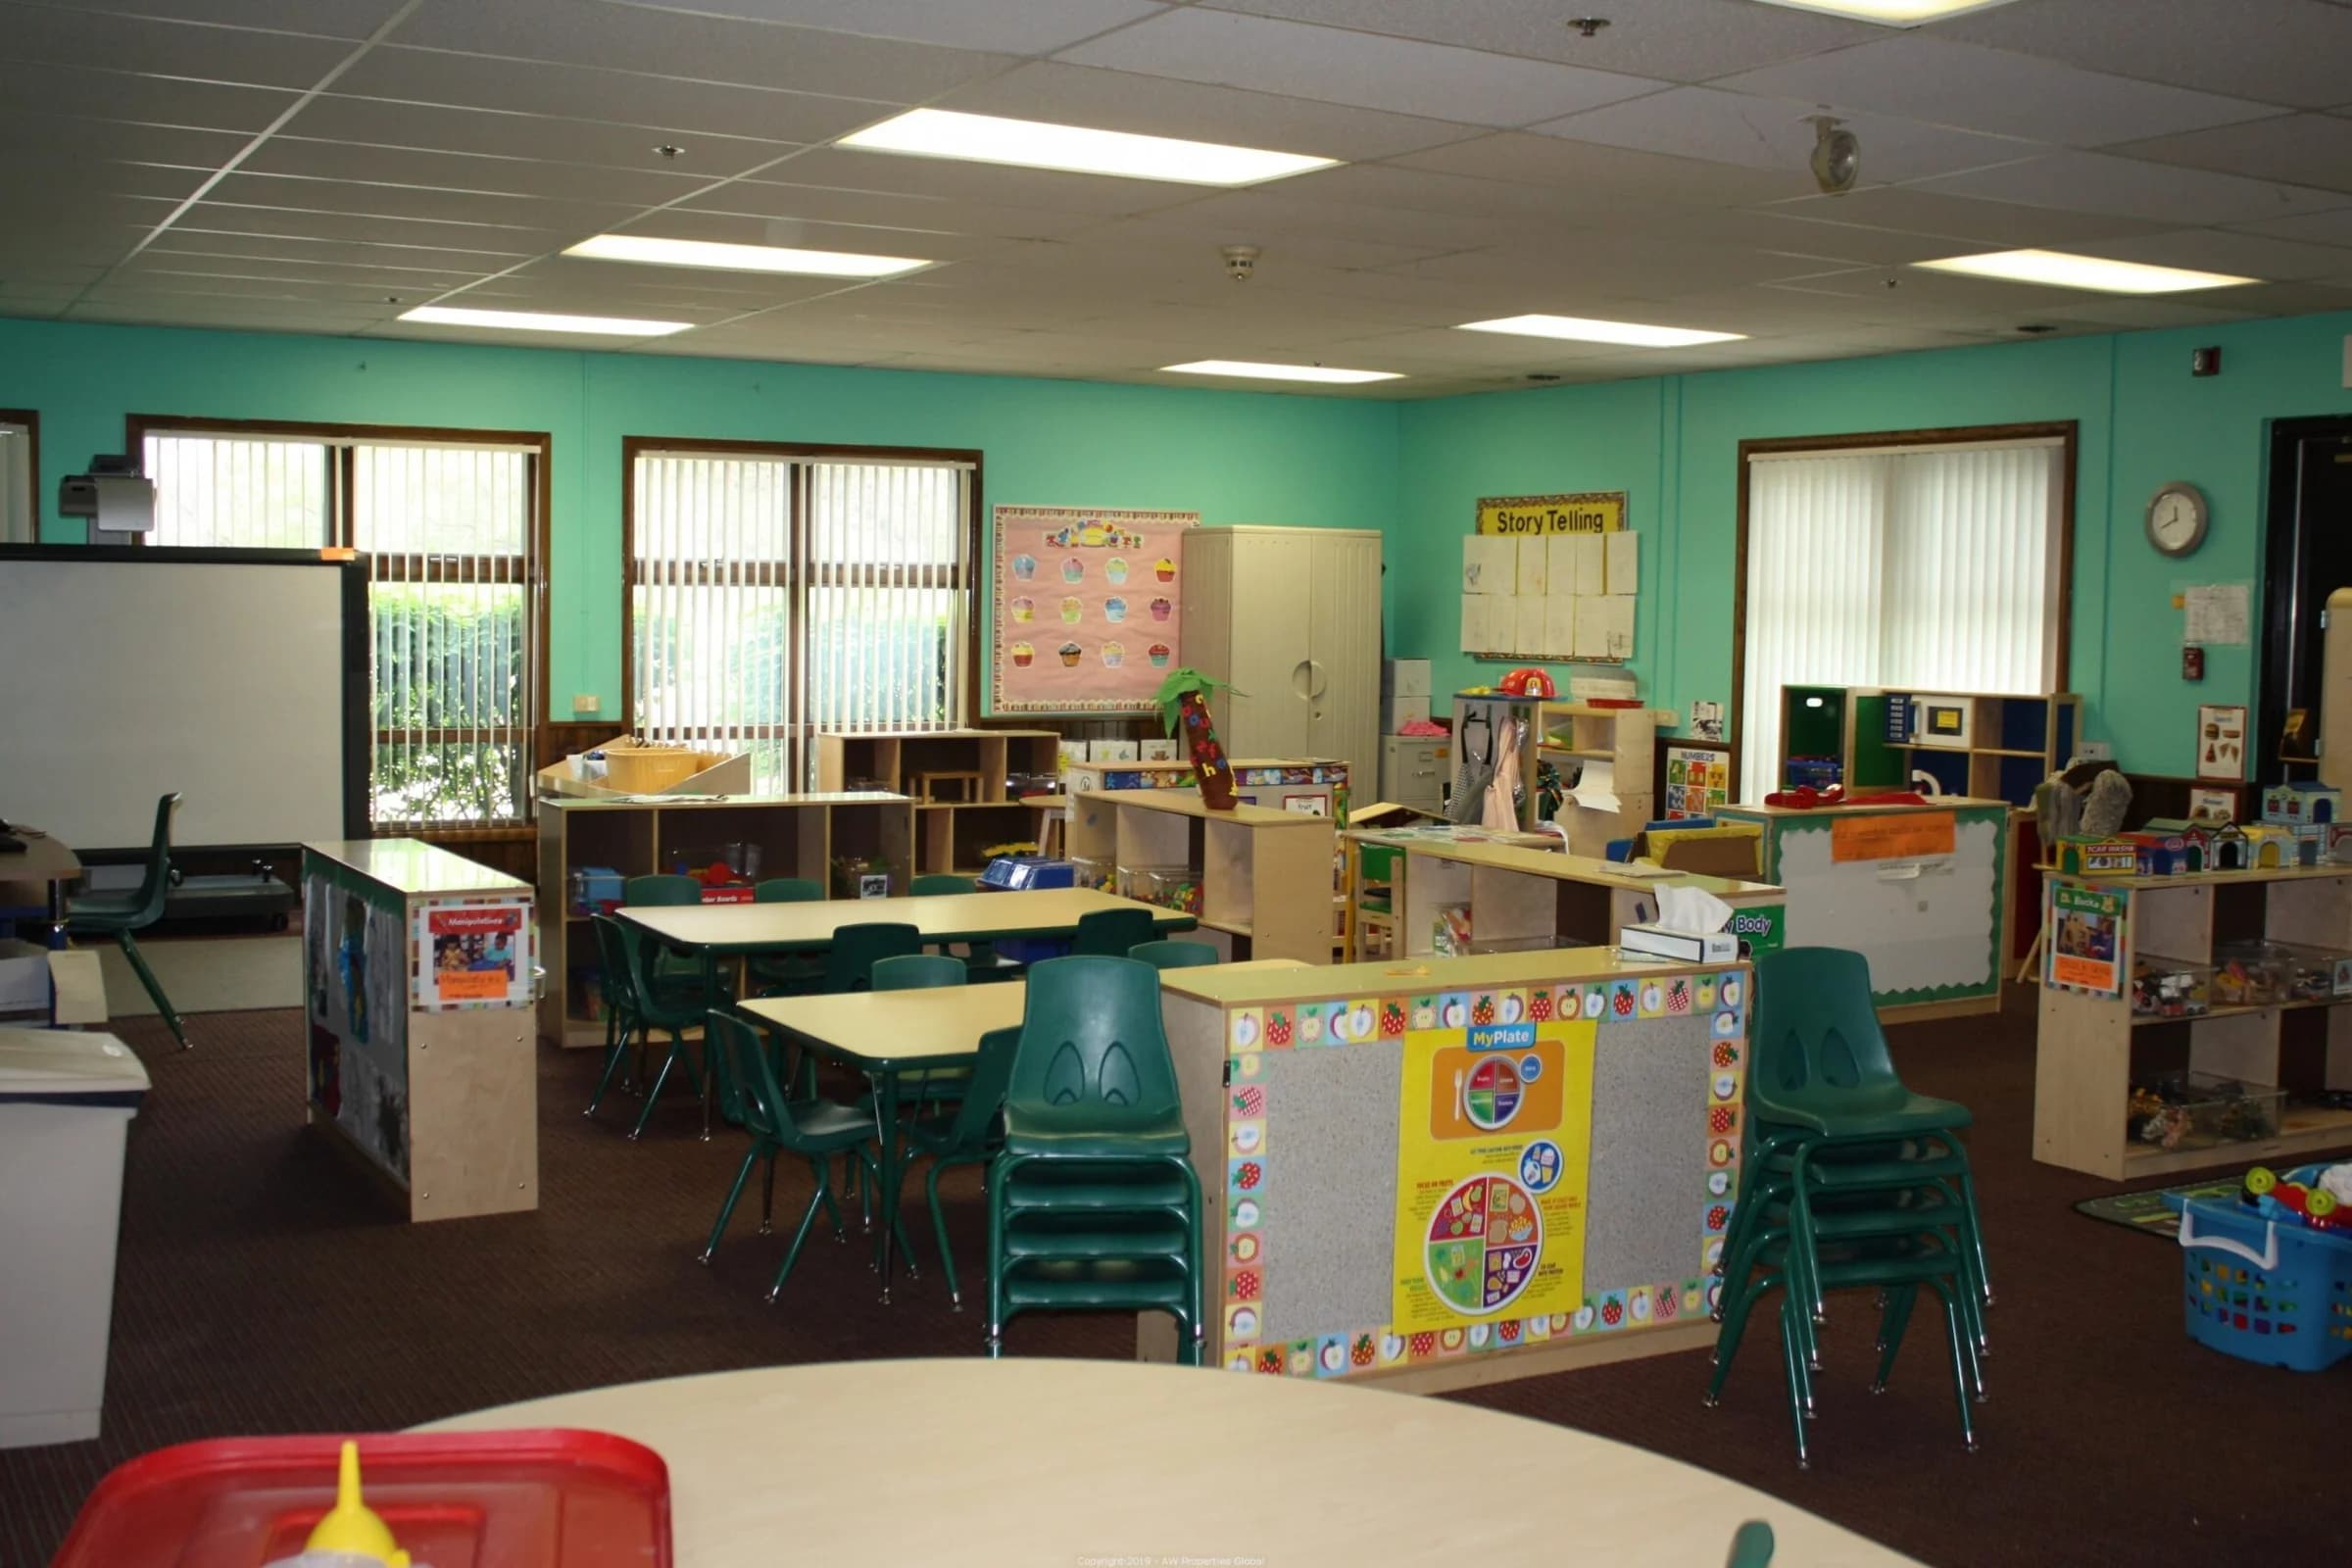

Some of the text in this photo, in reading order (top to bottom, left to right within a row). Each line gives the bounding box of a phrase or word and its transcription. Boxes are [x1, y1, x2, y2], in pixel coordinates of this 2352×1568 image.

[1496, 508, 1604, 535] Story Telling
[448, 916, 504, 928] Manipulatives
[1737, 913, 1772, 937] Body
[1473, 1029, 1530, 1048] MyPlate
